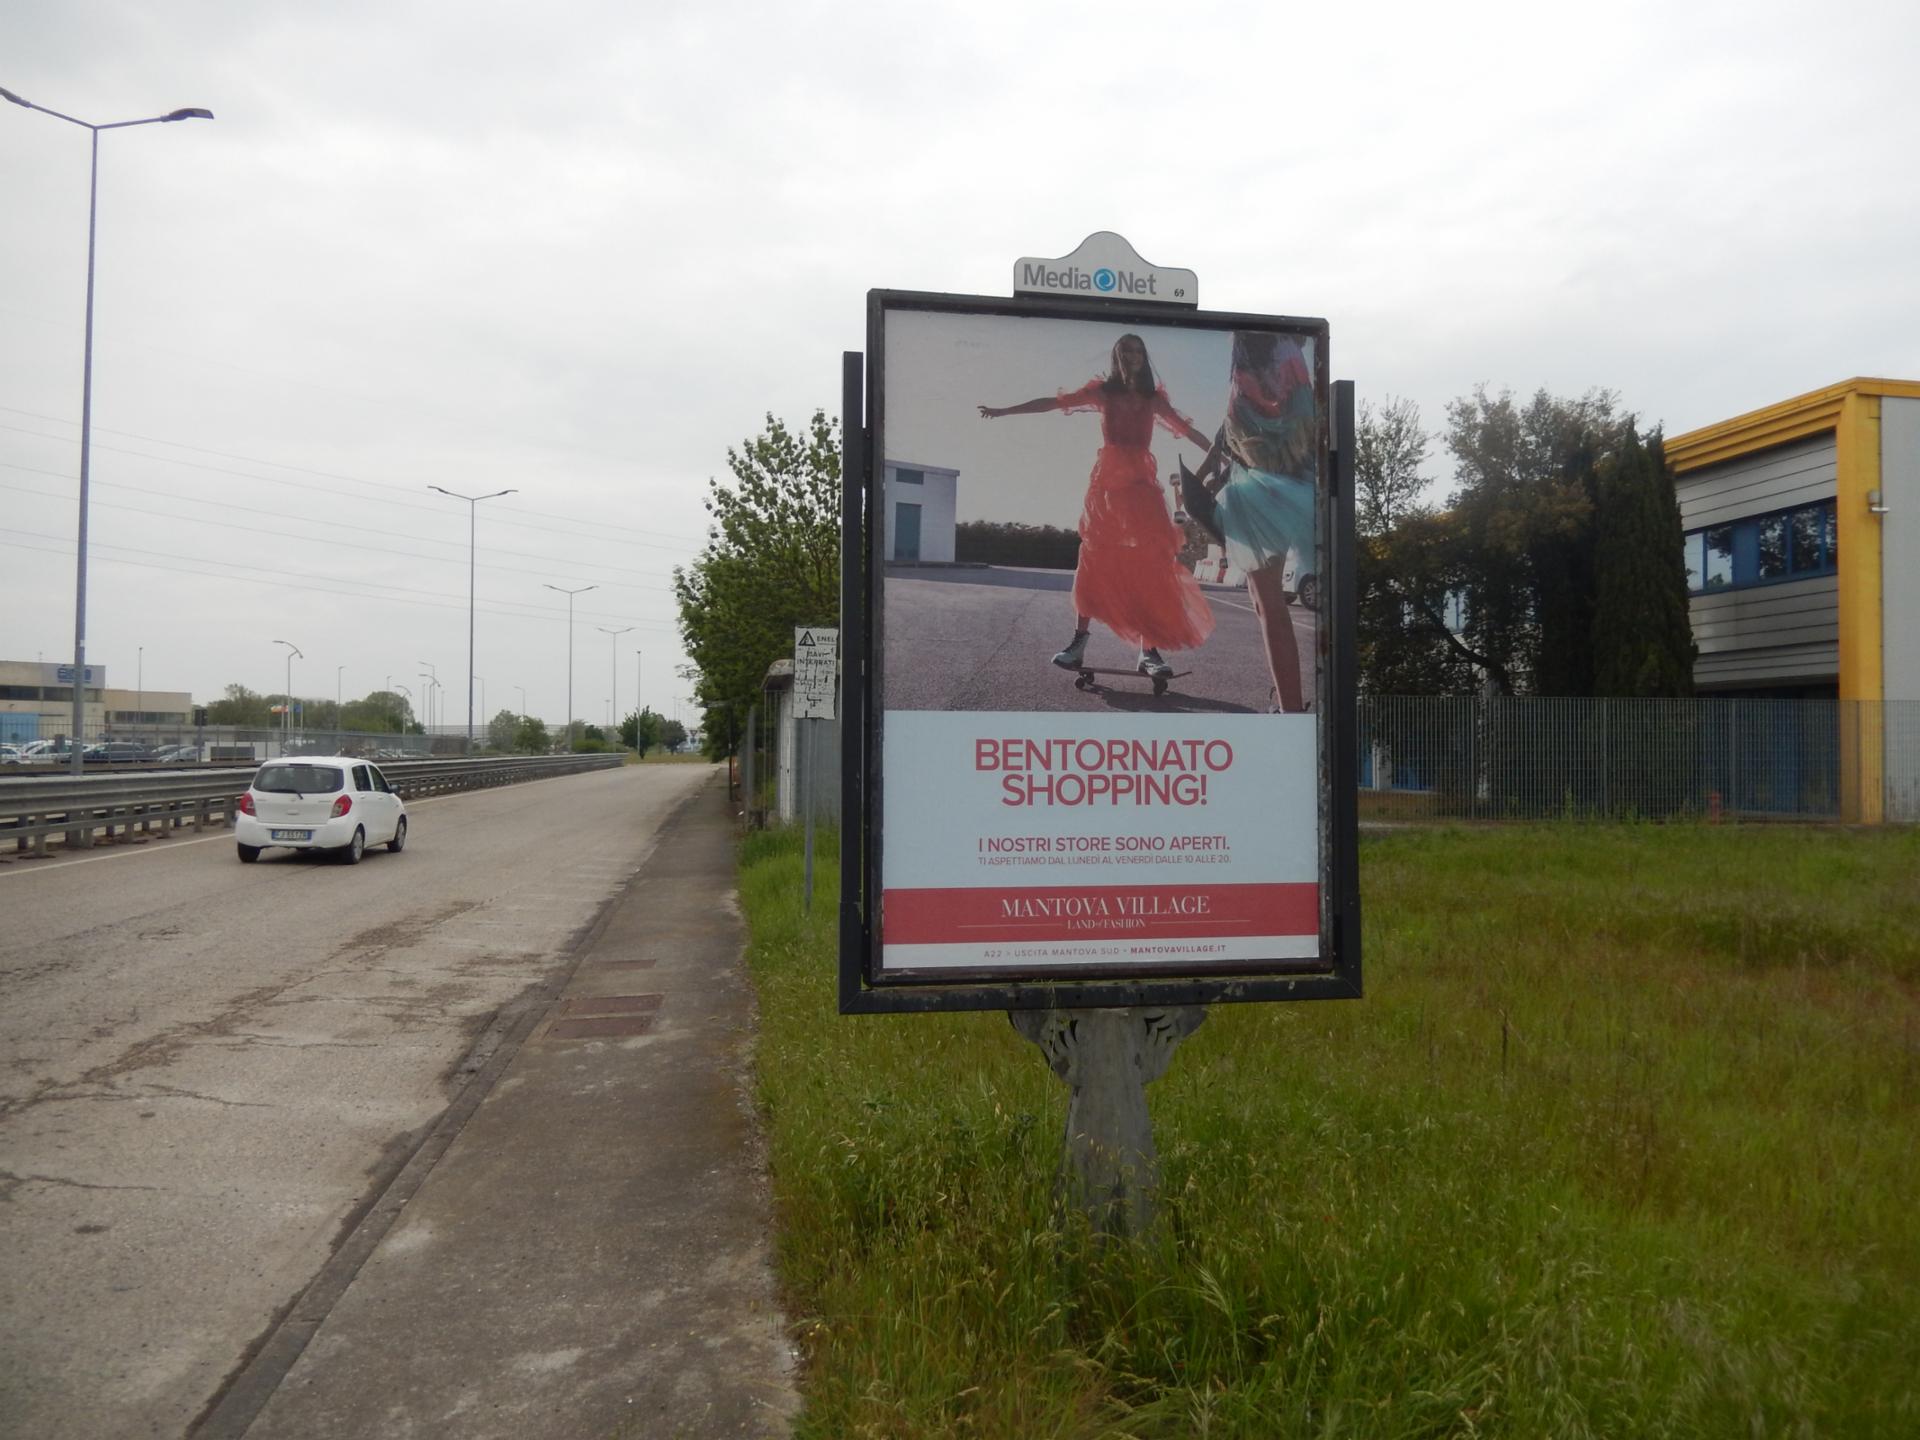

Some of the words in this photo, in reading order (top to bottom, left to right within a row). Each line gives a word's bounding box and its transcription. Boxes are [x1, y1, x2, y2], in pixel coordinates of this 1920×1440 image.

[1023, 263, 1091, 291] Media
[1118, 271, 1157, 295] Net
[1174, 288, 1185, 298] 69
[975, 738, 1234, 772] BENTORNATO
[1002, 773, 1207, 806] SHOPPING!
[978, 837, 983, 852] I
[988, 837, 1051, 852] NOSTRI
[1055, 836, 1111, 852] STORE
[1115, 836, 1165, 851] SONO
[1169, 835, 1230, 851] APERTI.
[988, 856, 1046, 866] ASPETTIAMO
[1048, 855, 1066, 865] DAL
[1155, 855, 1183, 864] DALLE
[1184, 854, 1194, 864] 10
[1195, 855, 1216, 864] ALLE
[1002, 898, 1110, 918] MANTOVA
[1116, 895, 1211, 916] VILLAGE
[1067, 919, 1095, 929] LAND
[1104, 918, 1146, 929] FASHION
[984, 950, 1002, 959] A22
[1014, 948, 1049, 957] USCITA
[1052, 948, 1098, 956] MANTOVA
[1101, 947, 1120, 955] SUD
[1131, 944, 1226, 954] MANTOVAVILLAGE.IT
